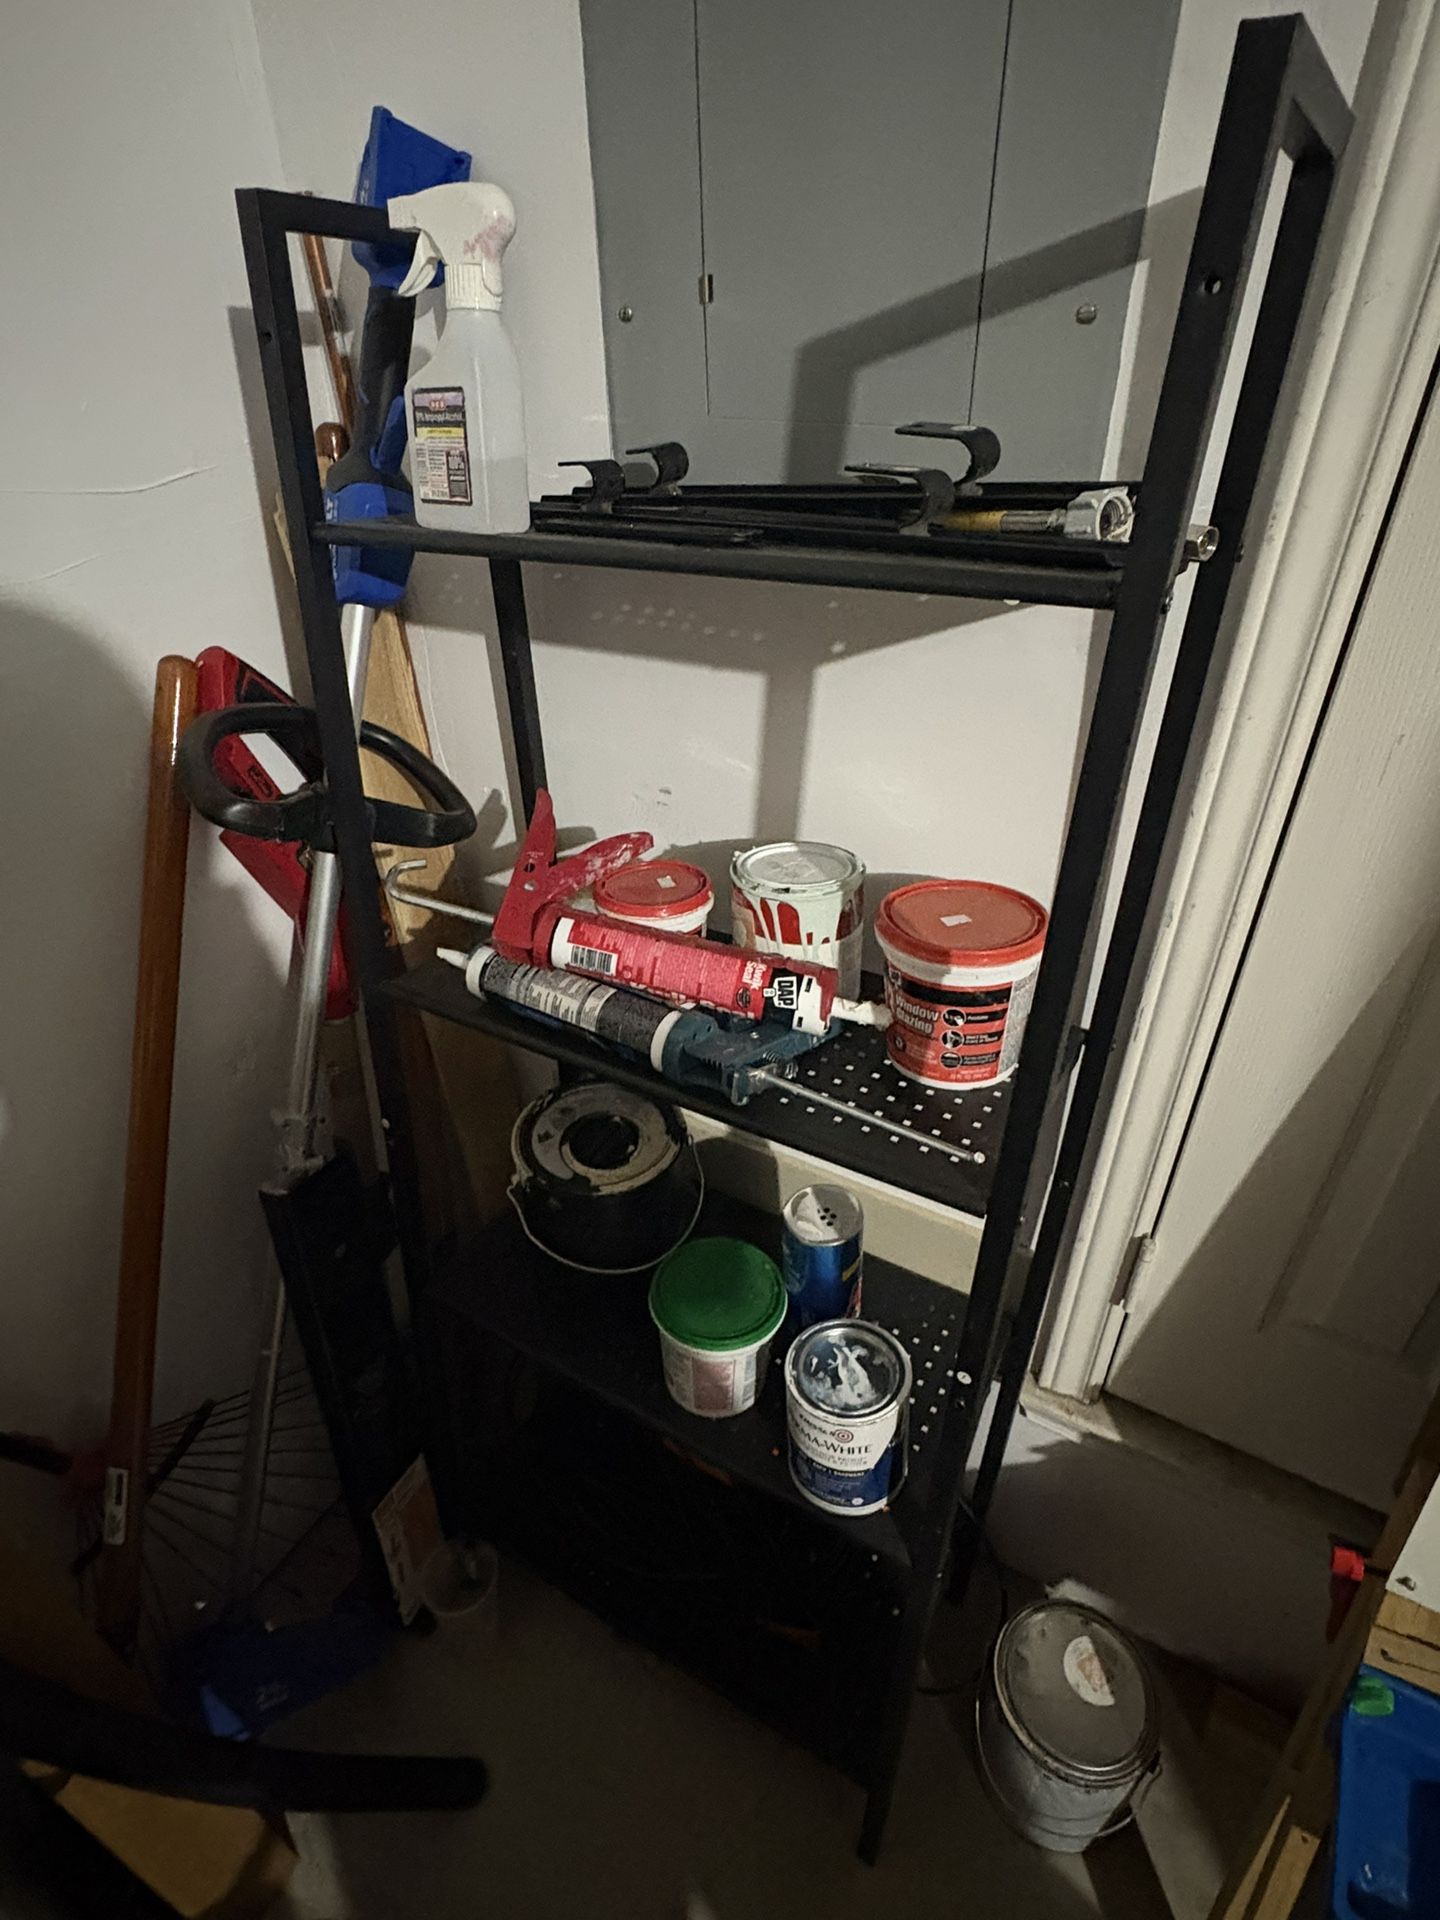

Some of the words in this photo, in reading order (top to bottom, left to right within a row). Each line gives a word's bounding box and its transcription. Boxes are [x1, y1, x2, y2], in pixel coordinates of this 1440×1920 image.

[742, 961, 756, 984] Seal
[751, 962, 767, 990] Kwik
[896, 994, 938, 1021] Window
[896, 1008, 933, 1034] Glazing
